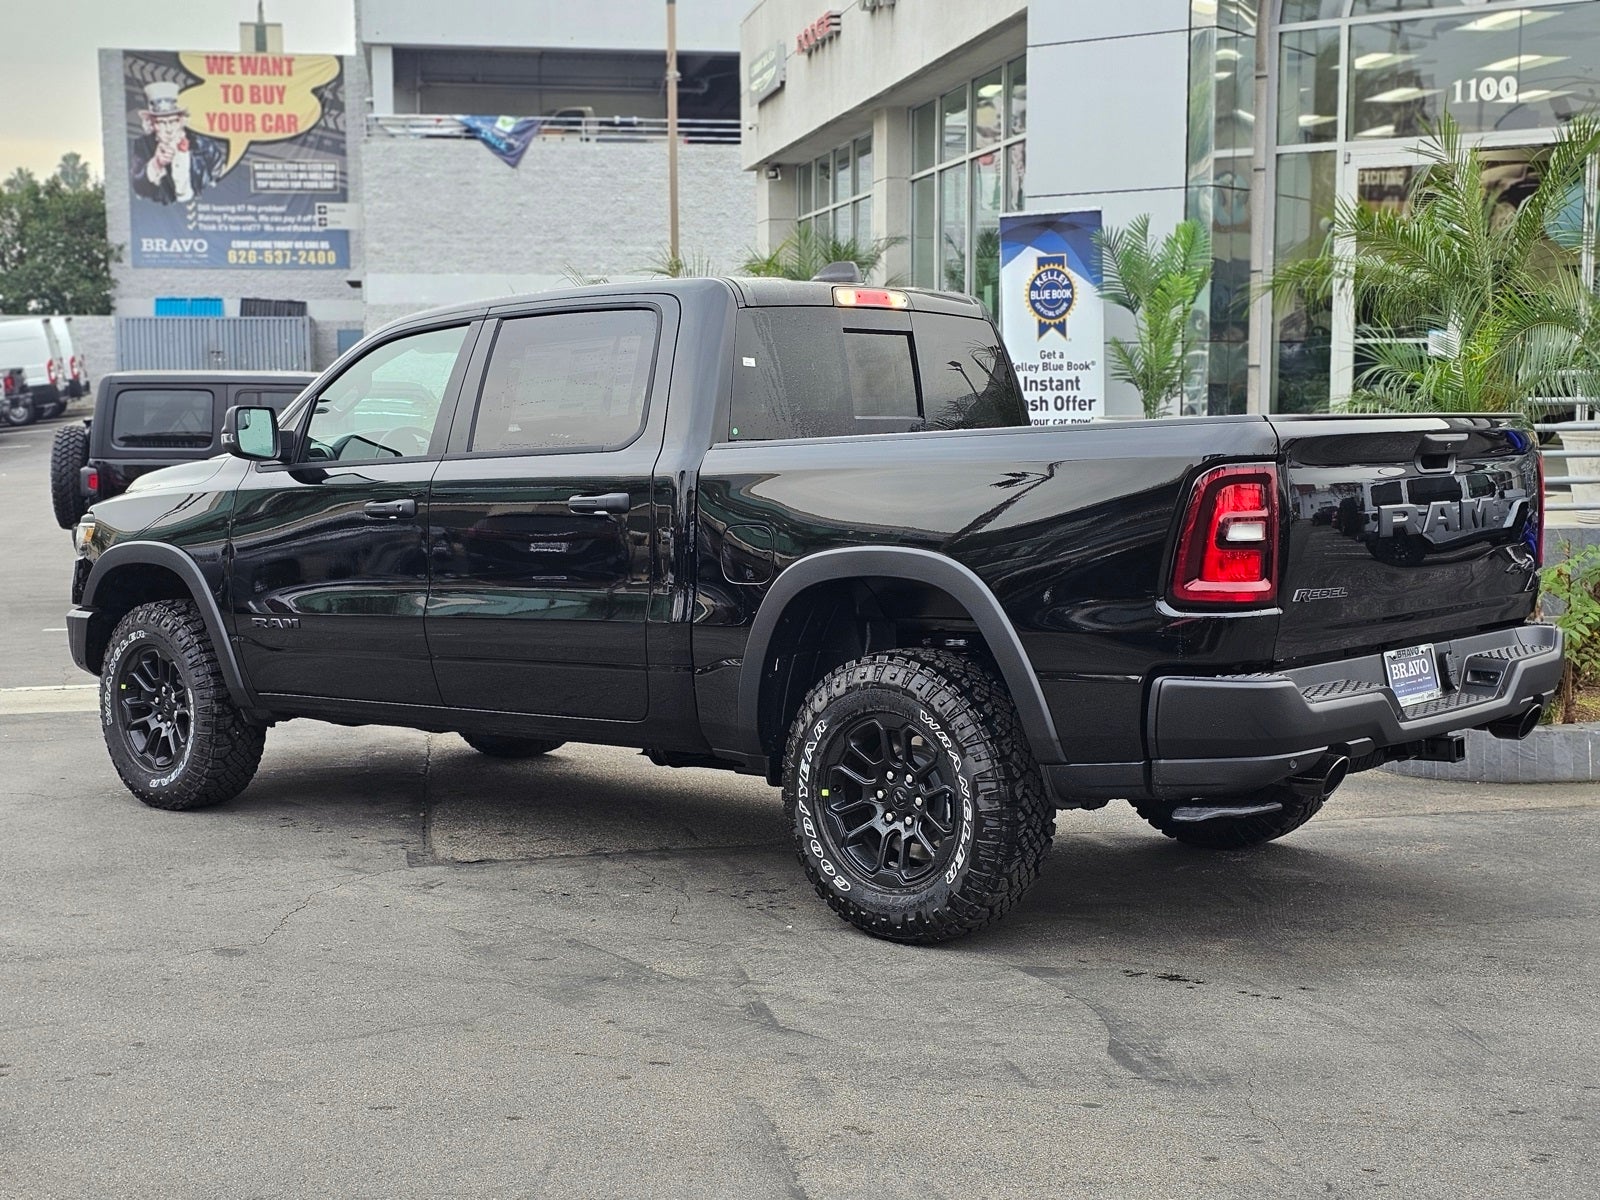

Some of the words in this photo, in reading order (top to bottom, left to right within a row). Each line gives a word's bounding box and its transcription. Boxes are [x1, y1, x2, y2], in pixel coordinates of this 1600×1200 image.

[205, 55, 236, 75] WE
[239, 56, 295, 76] WANT
[220, 84, 244, 104] TO
[249, 84, 286, 105] BUY
[1452, 76, 1518, 104] 1100
[205, 112, 256, 133] YOUR
[260, 113, 299, 133] CAR
[141, 238, 208, 253] BRAVO
[1034, 270, 1070, 287] KELLEY
[1030, 290, 1051, 300] BLUE
[1052, 288, 1073, 299] BOOK
[1039, 350, 1056, 360] Get
[1058, 351, 1065, 360] a
[1041, 361, 1065, 372] Blue
[1023, 375, 1081, 392] Instant
[1024, 395, 1049, 412] sh
[1053, 395, 1097, 412] Offer
[1377, 498, 1499, 540] RAM
[1292, 586, 1349, 603] REBEL
[251, 617, 301, 629] RAM
[1396, 646, 1420, 659] BRAVO
[1390, 657, 1430, 681] BRAVO
[798, 719, 851, 892] GOODYEAR
[919, 709, 973, 885] WRANGLER
